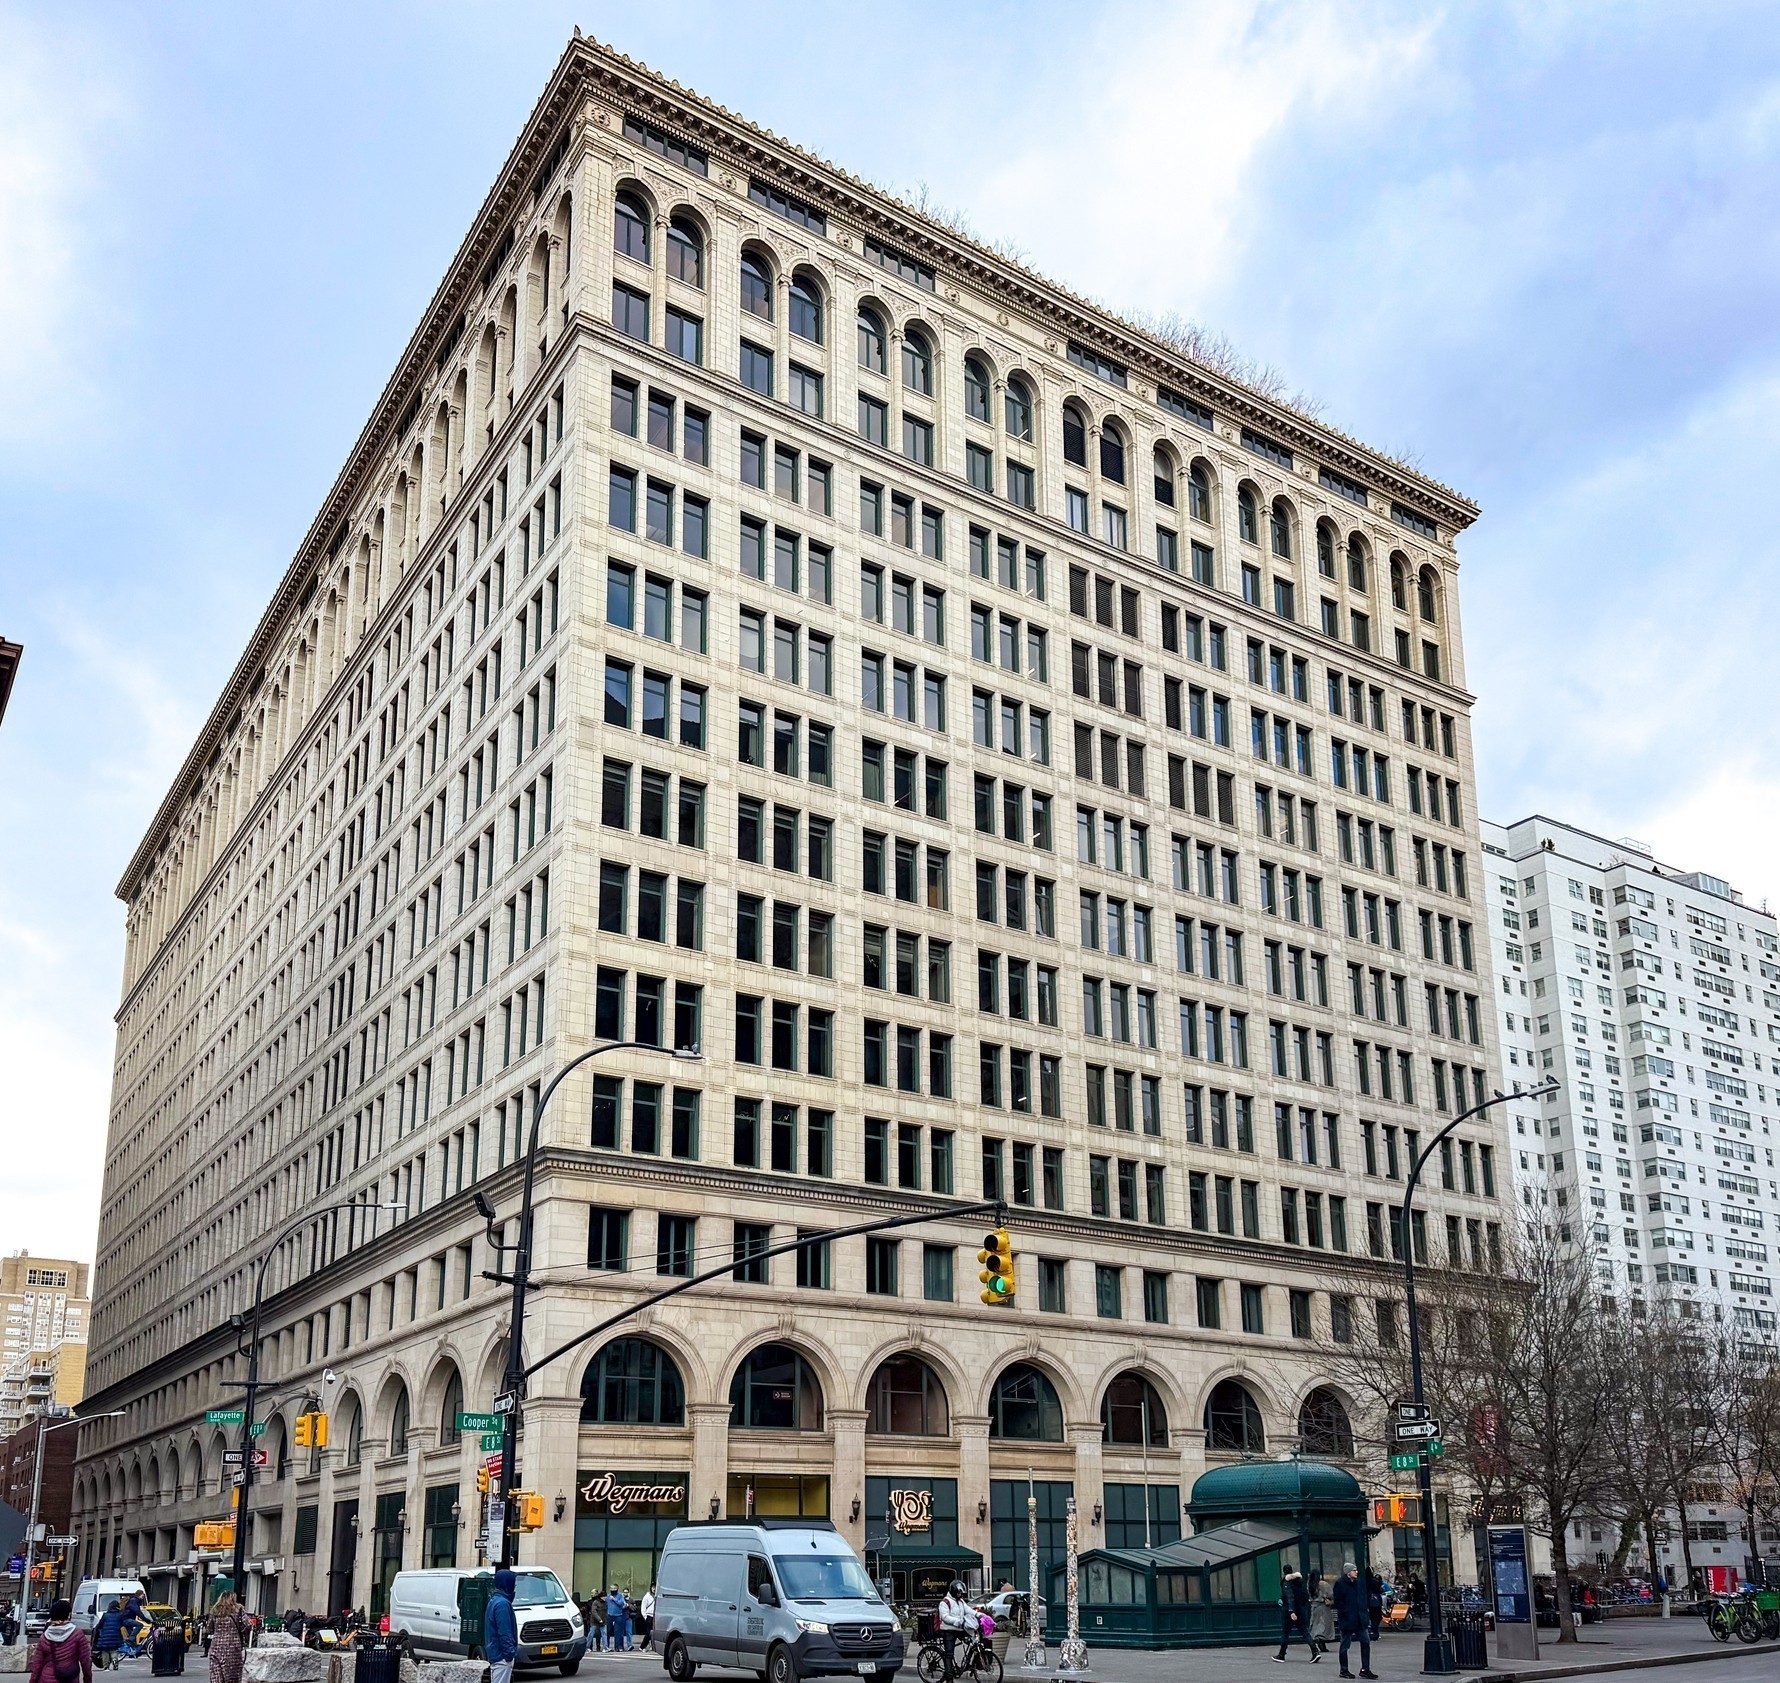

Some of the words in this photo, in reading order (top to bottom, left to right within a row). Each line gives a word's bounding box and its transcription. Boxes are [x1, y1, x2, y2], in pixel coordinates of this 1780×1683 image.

[495, 1402, 503, 1410] ONE
[1402, 1408, 1412, 1416] ONE
[210, 1412, 241, 1421] Lafayette
[463, 1415, 489, 1430] Cooper
[492, 1416, 498, 1426] Sq
[1402, 1427, 1415, 1435] ONE
[1420, 1425, 1433, 1434] WAY
[486, 1436, 490, 1449] E
[491, 1436, 496, 1449] 8
[1396, 1457, 1401, 1468] E
[1402, 1456, 1408, 1468] 8
[581, 1472, 685, 1514] Wegmans
[921, 1577, 948, 1590] Wegmans
